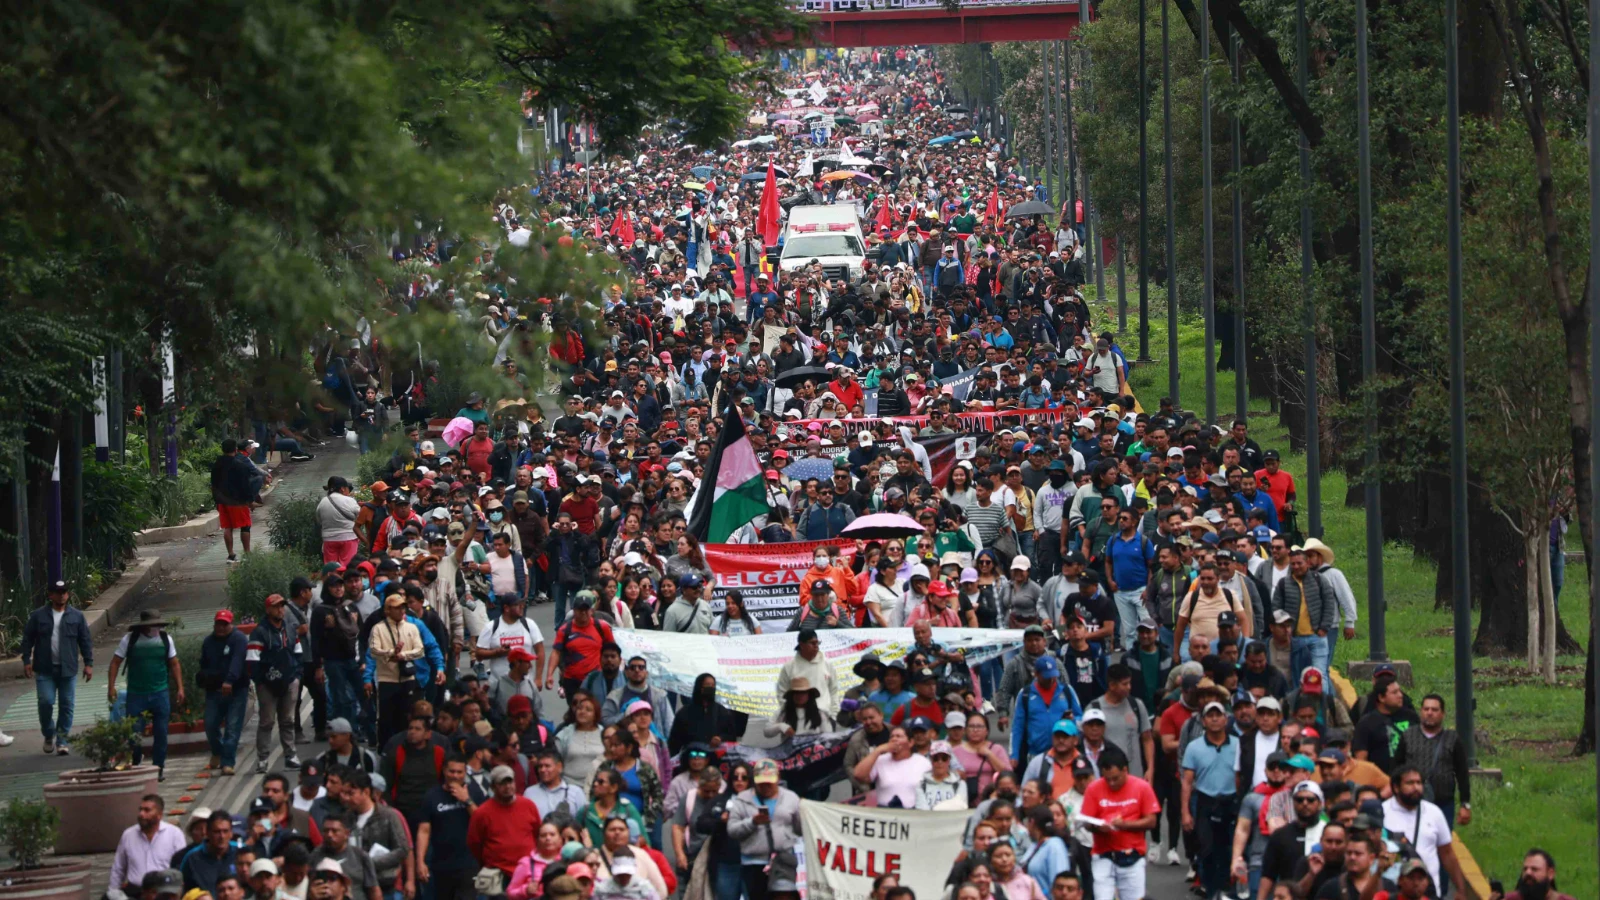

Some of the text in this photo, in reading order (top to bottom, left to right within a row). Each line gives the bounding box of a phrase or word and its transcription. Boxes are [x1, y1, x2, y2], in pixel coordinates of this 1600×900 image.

[714, 570, 801, 587] ELGA
[772, 587, 785, 596] DE
[786, 586, 798, 594] LA
[841, 816, 910, 840] REGIÓN
[817, 838, 901, 881] VALLE
